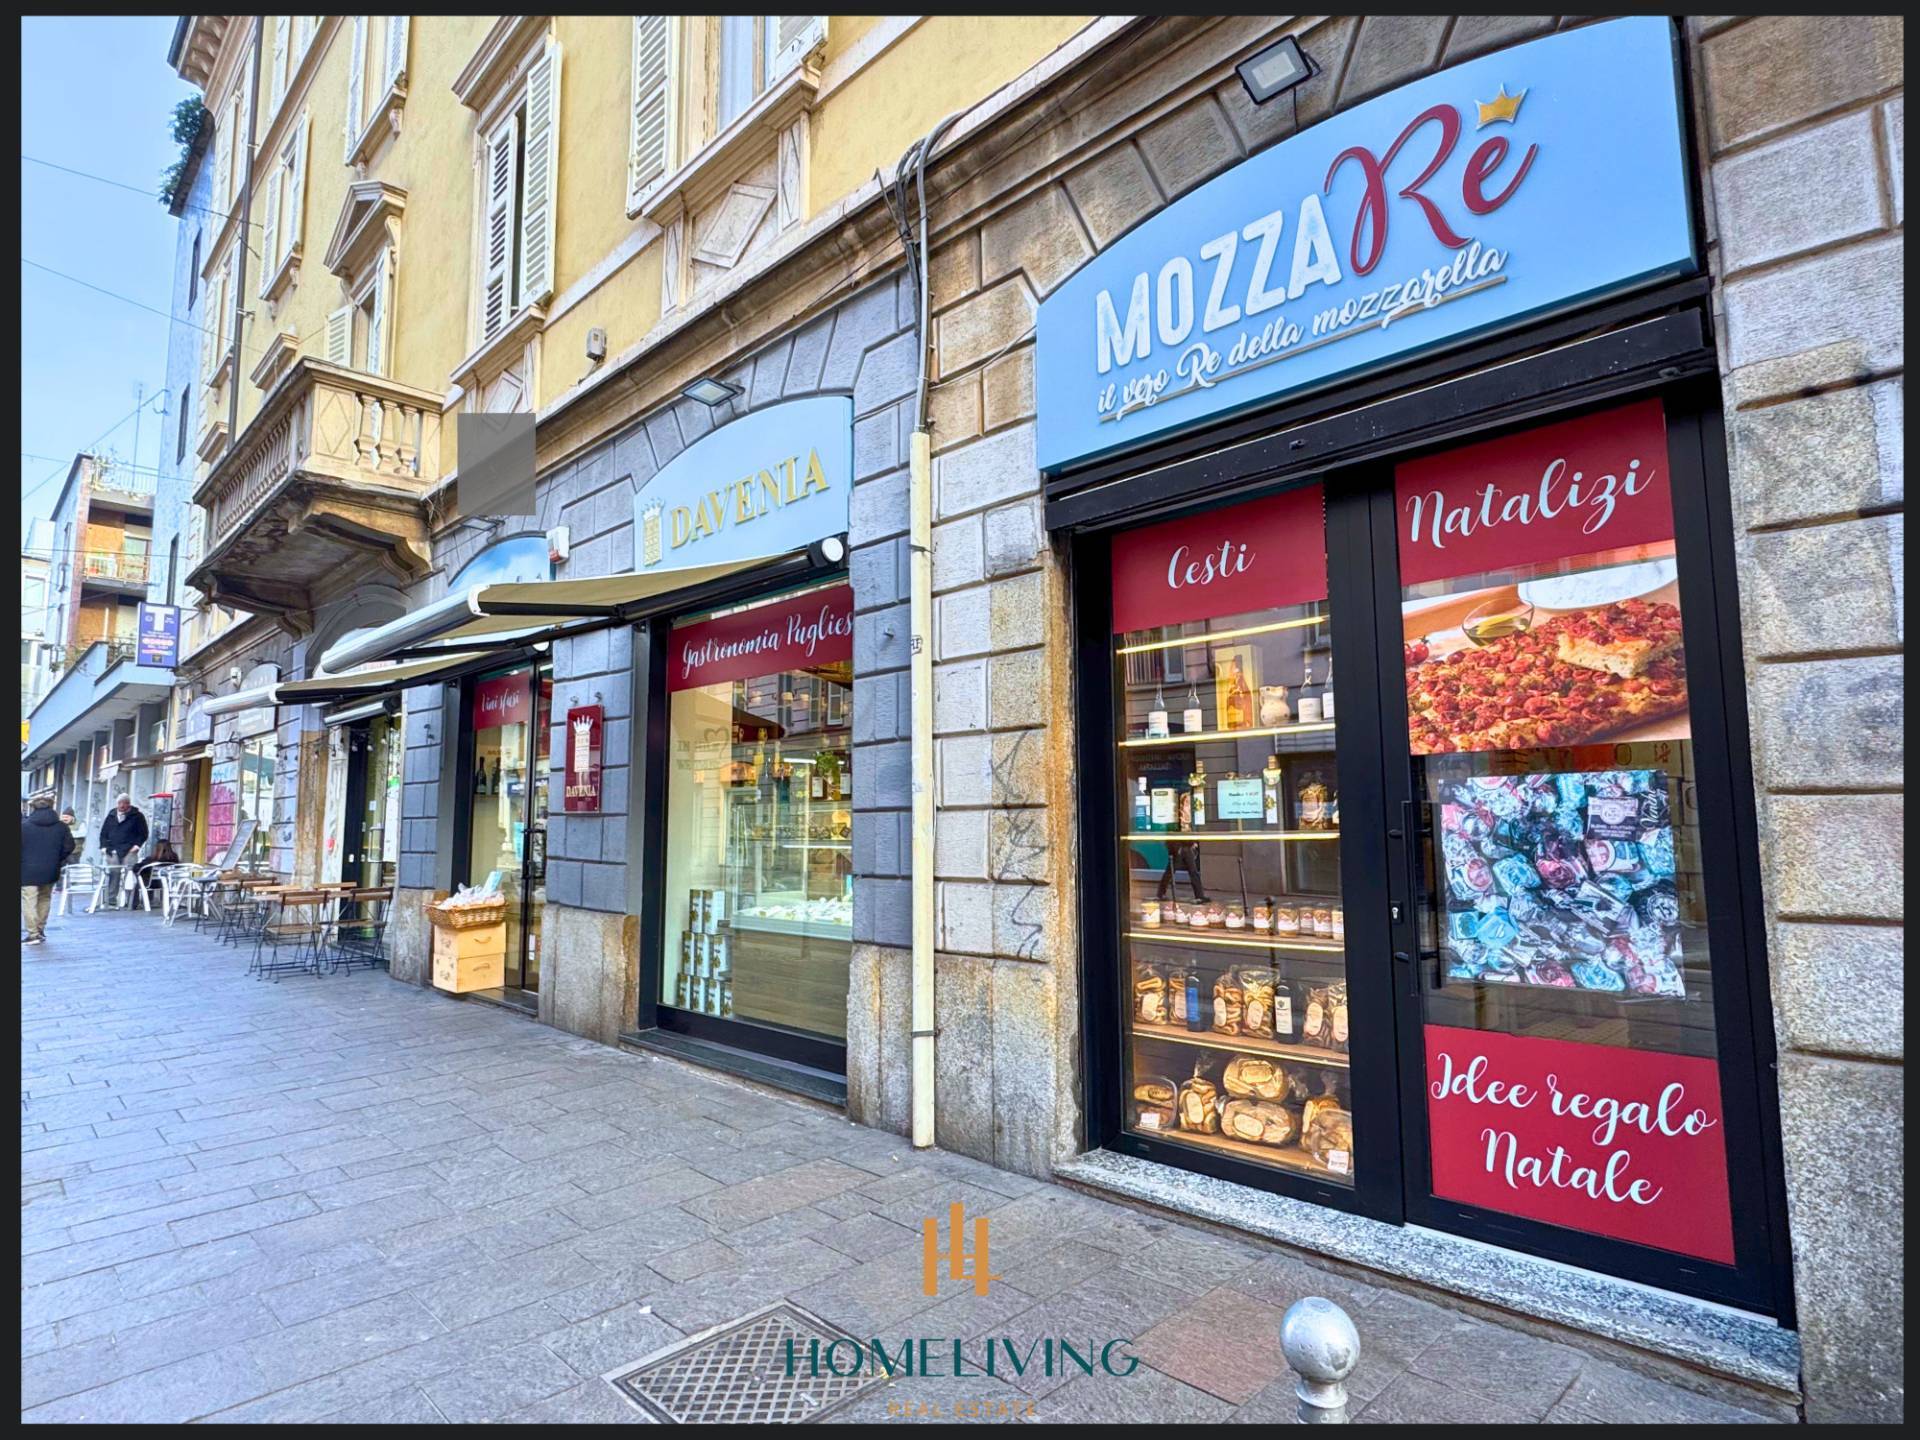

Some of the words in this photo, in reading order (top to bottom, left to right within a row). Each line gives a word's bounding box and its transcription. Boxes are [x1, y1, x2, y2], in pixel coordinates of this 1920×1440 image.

[1097, 384, 1119, 413] il
[1117, 368, 1170, 420] vero
[1177, 341, 1222, 389] Re
[1228, 316, 1304, 366] della
[1311, 240, 1508, 329] mozzarella
[670, 448, 831, 549] DAVENIA
[1405, 458, 1656, 548] Natalizi
[1167, 540, 1256, 589] Cesti
[145, 605, 175, 632] T
[682, 627, 782, 679] Gastronomia
[566, 784, 596, 798] DAVENIA
[1431, 1052, 1538, 1108] Idee
[1546, 1074, 1718, 1146] regalo
[1480, 1128, 1663, 1205] Natale
